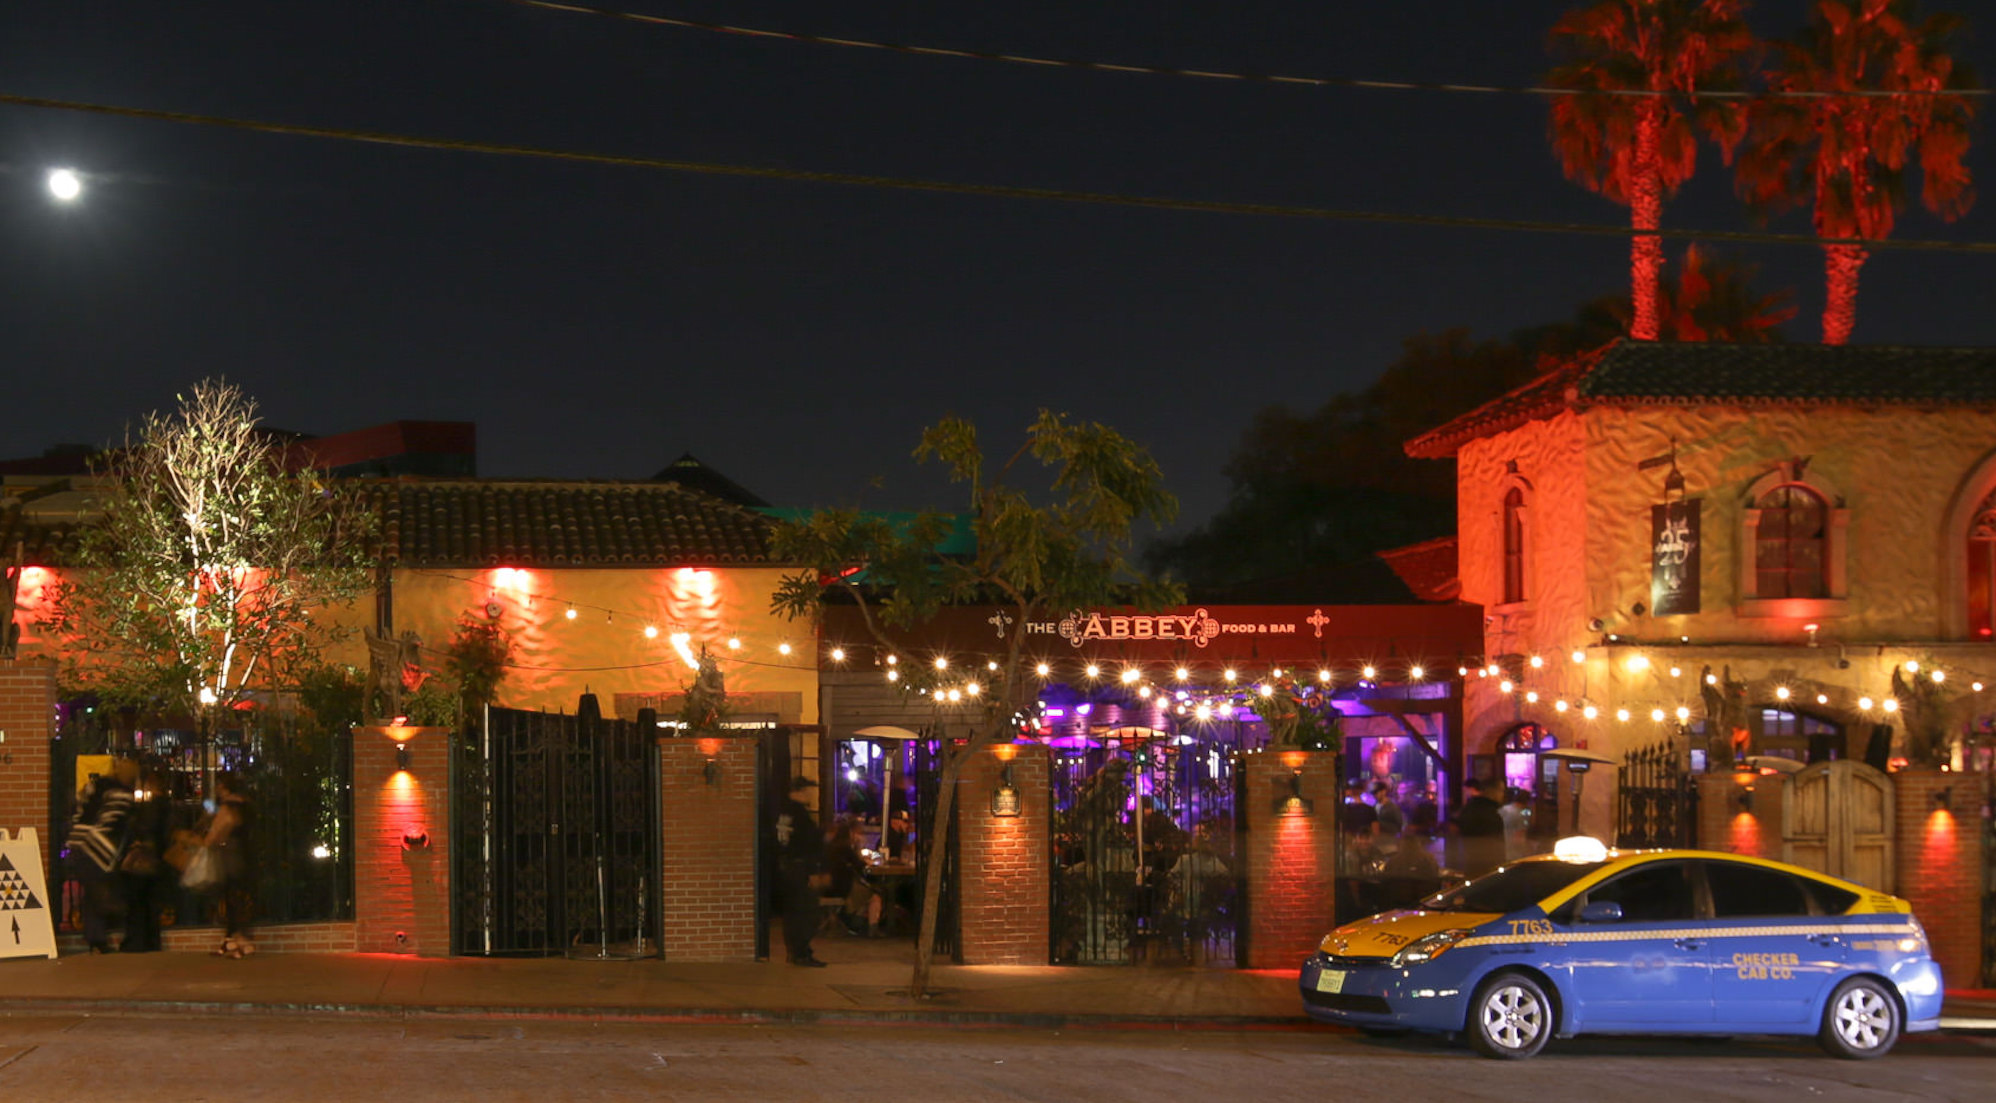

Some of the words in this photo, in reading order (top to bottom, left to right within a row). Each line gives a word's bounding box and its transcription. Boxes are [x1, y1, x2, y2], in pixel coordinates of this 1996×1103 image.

[1026, 622, 1056, 634] THE
[1083, 614, 1198, 638] ABBEY
[1221, 623, 1257, 634] FOOD
[1257, 623, 1268, 634] &
[1269, 623, 1296, 634] BAR
[1507, 918, 1554, 936] 7763
[1372, 931, 1410, 947] 7763
[1732, 952, 1800, 966] CHECKER
[1737, 966, 1769, 981] CAB
[1770, 966, 1797, 981] CO.
